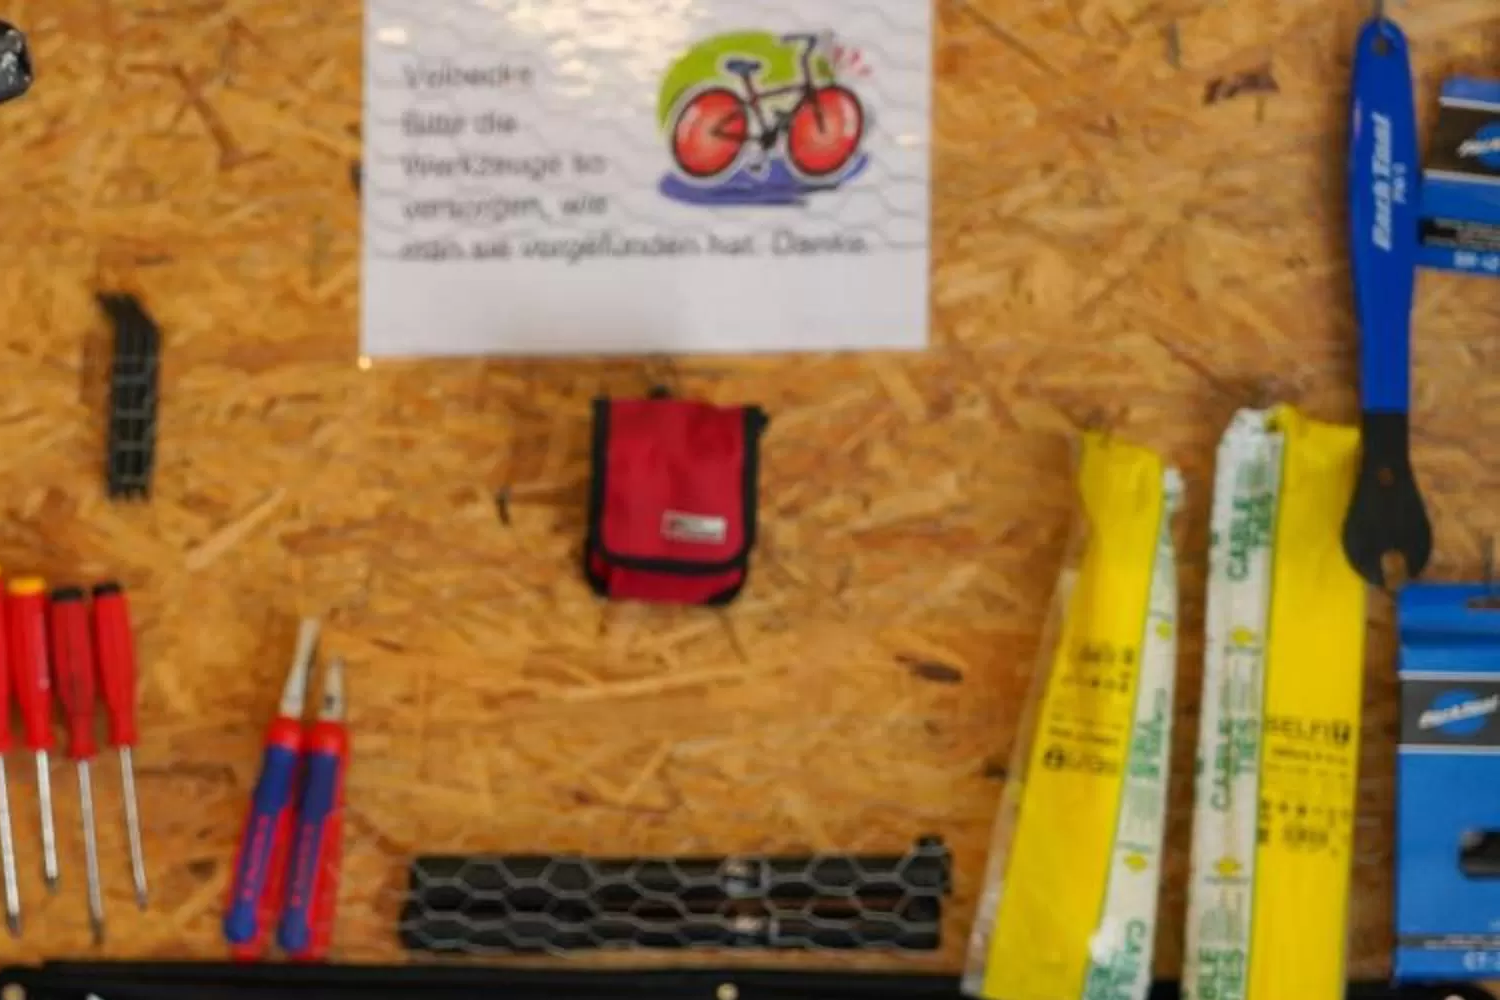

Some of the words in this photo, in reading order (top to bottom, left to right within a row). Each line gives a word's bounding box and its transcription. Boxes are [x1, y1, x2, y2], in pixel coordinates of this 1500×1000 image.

[474, 111, 517, 136] die
[1210, 718, 1236, 812] CABLE
[1233, 716, 1258, 774] TIES
